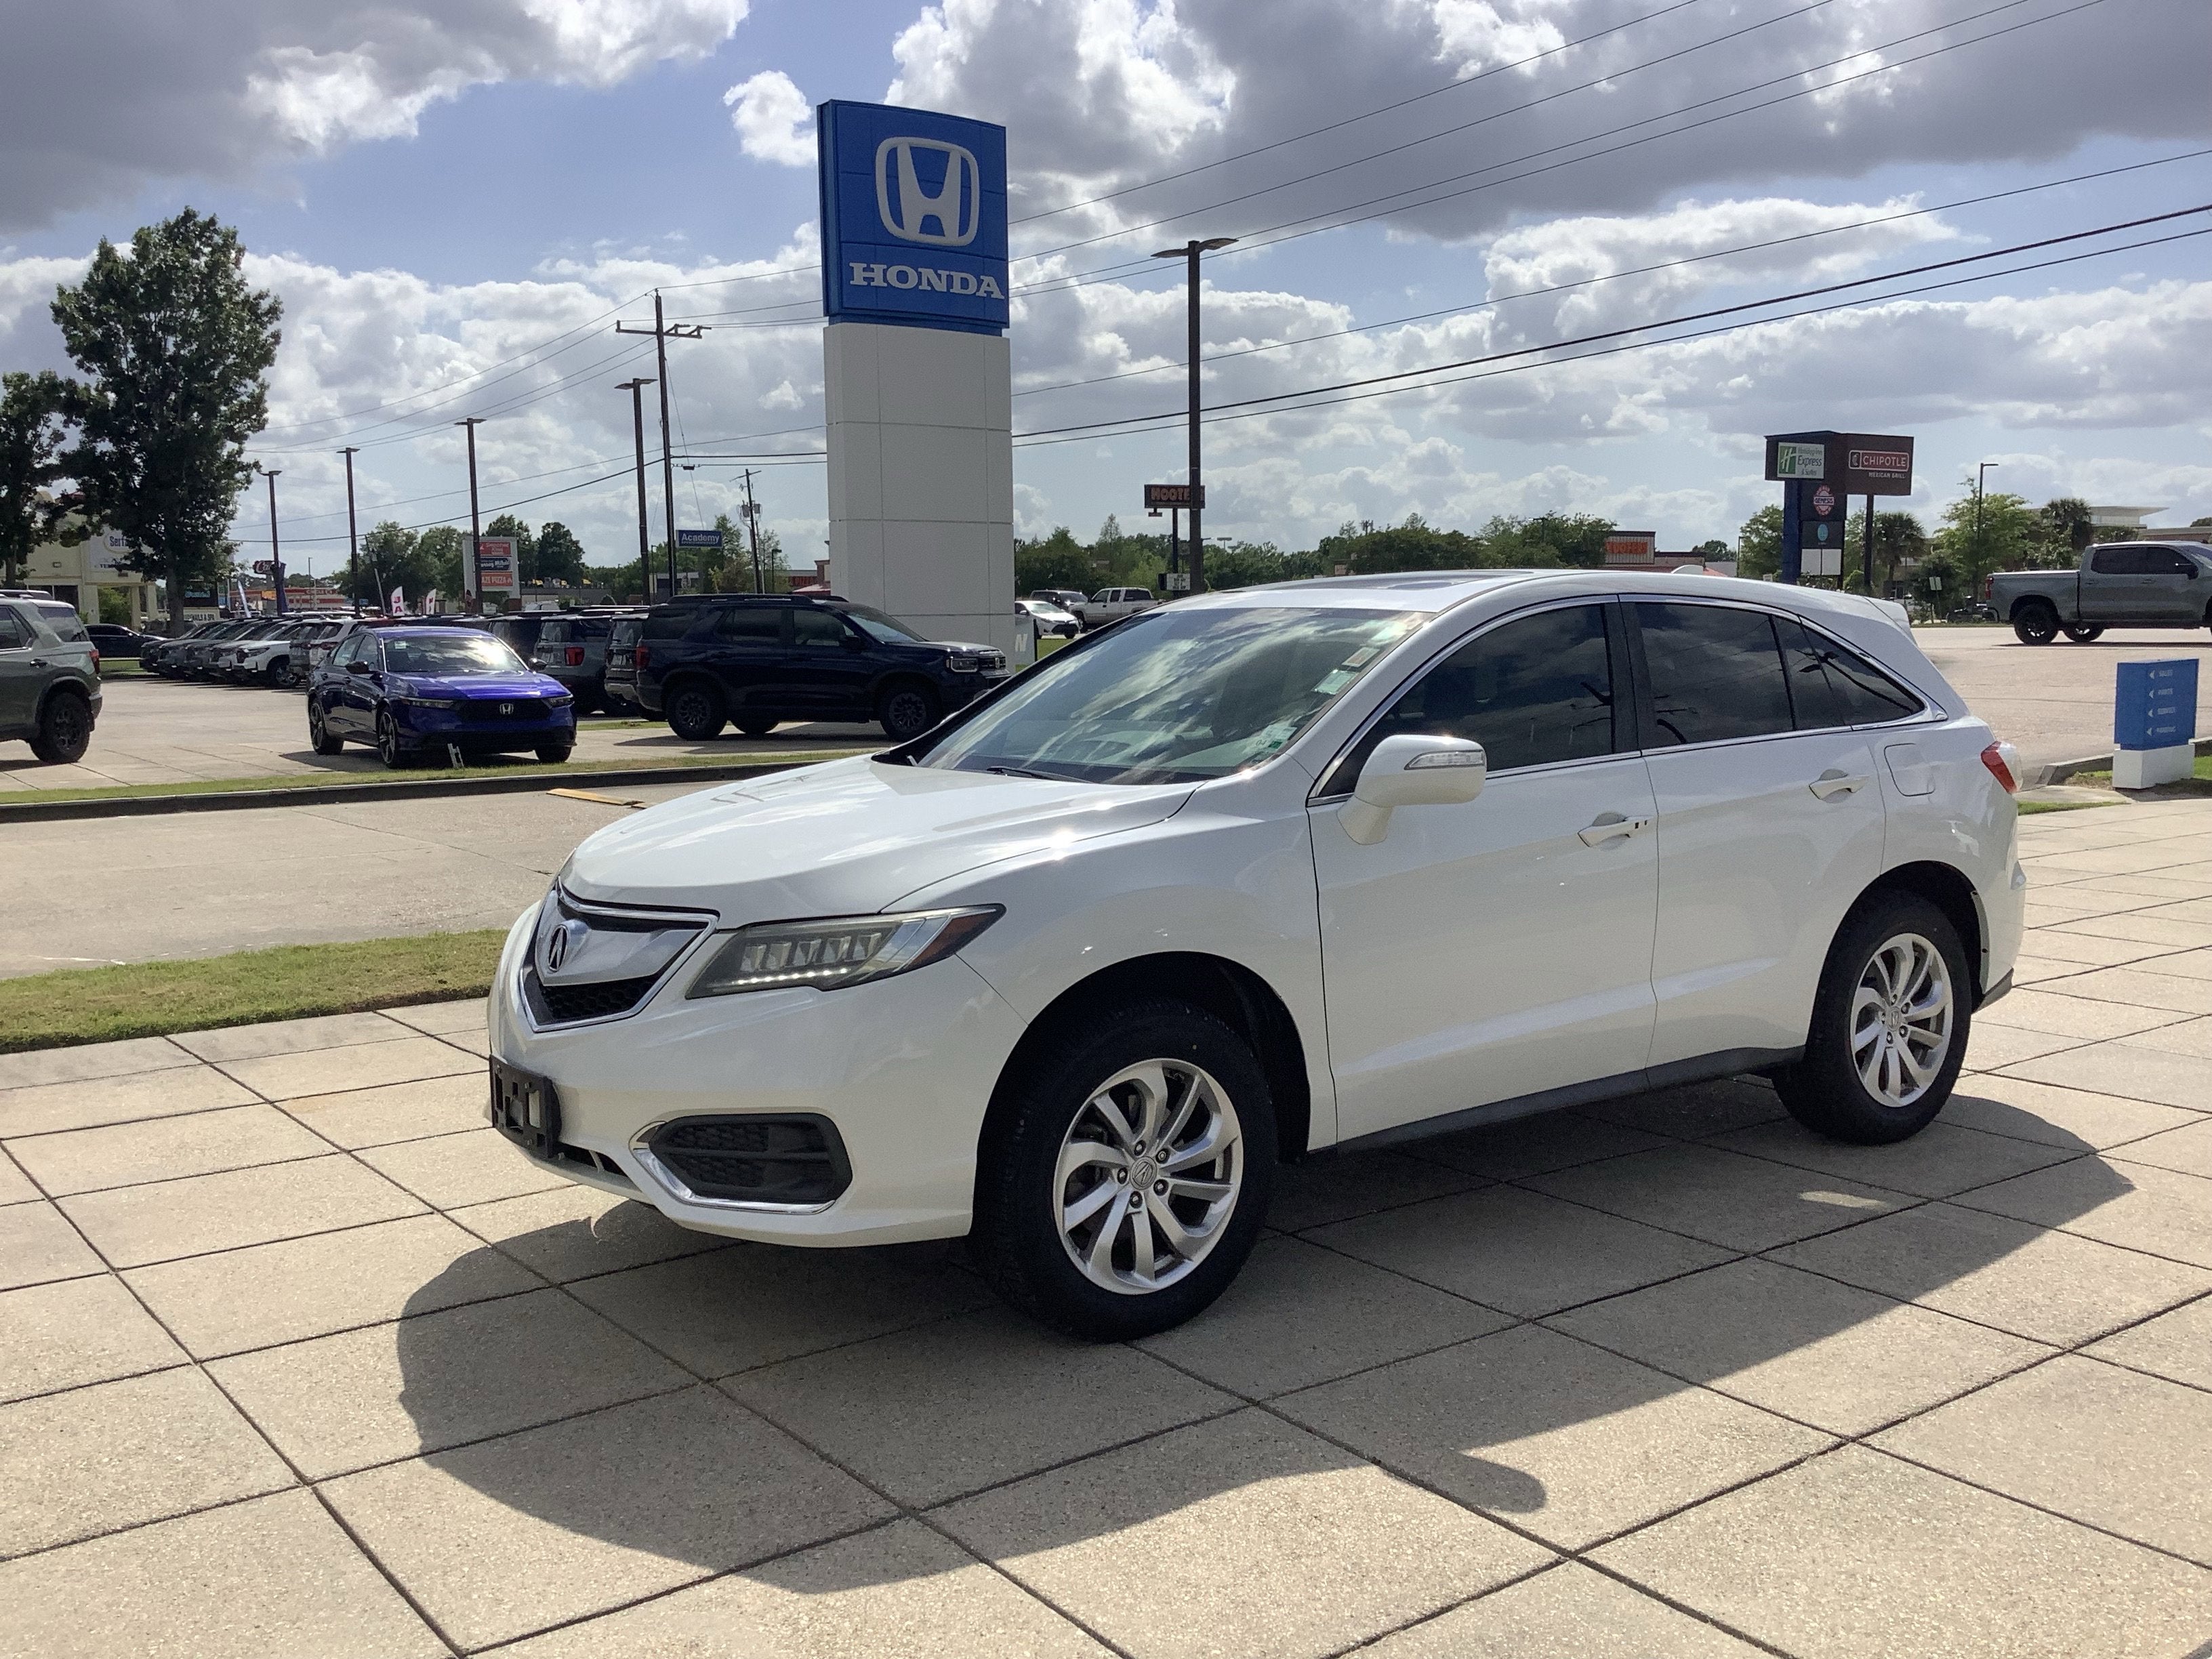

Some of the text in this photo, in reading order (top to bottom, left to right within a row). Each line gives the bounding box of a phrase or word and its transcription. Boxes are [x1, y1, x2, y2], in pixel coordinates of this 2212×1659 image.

[849, 262, 1004, 300] HONDA
[1797, 455, 1822, 468] Express
[1862, 455, 1906, 467] CHIPOTLE
[1151, 487, 1204, 501] HOOTE
[681, 533, 720, 544] Academy
